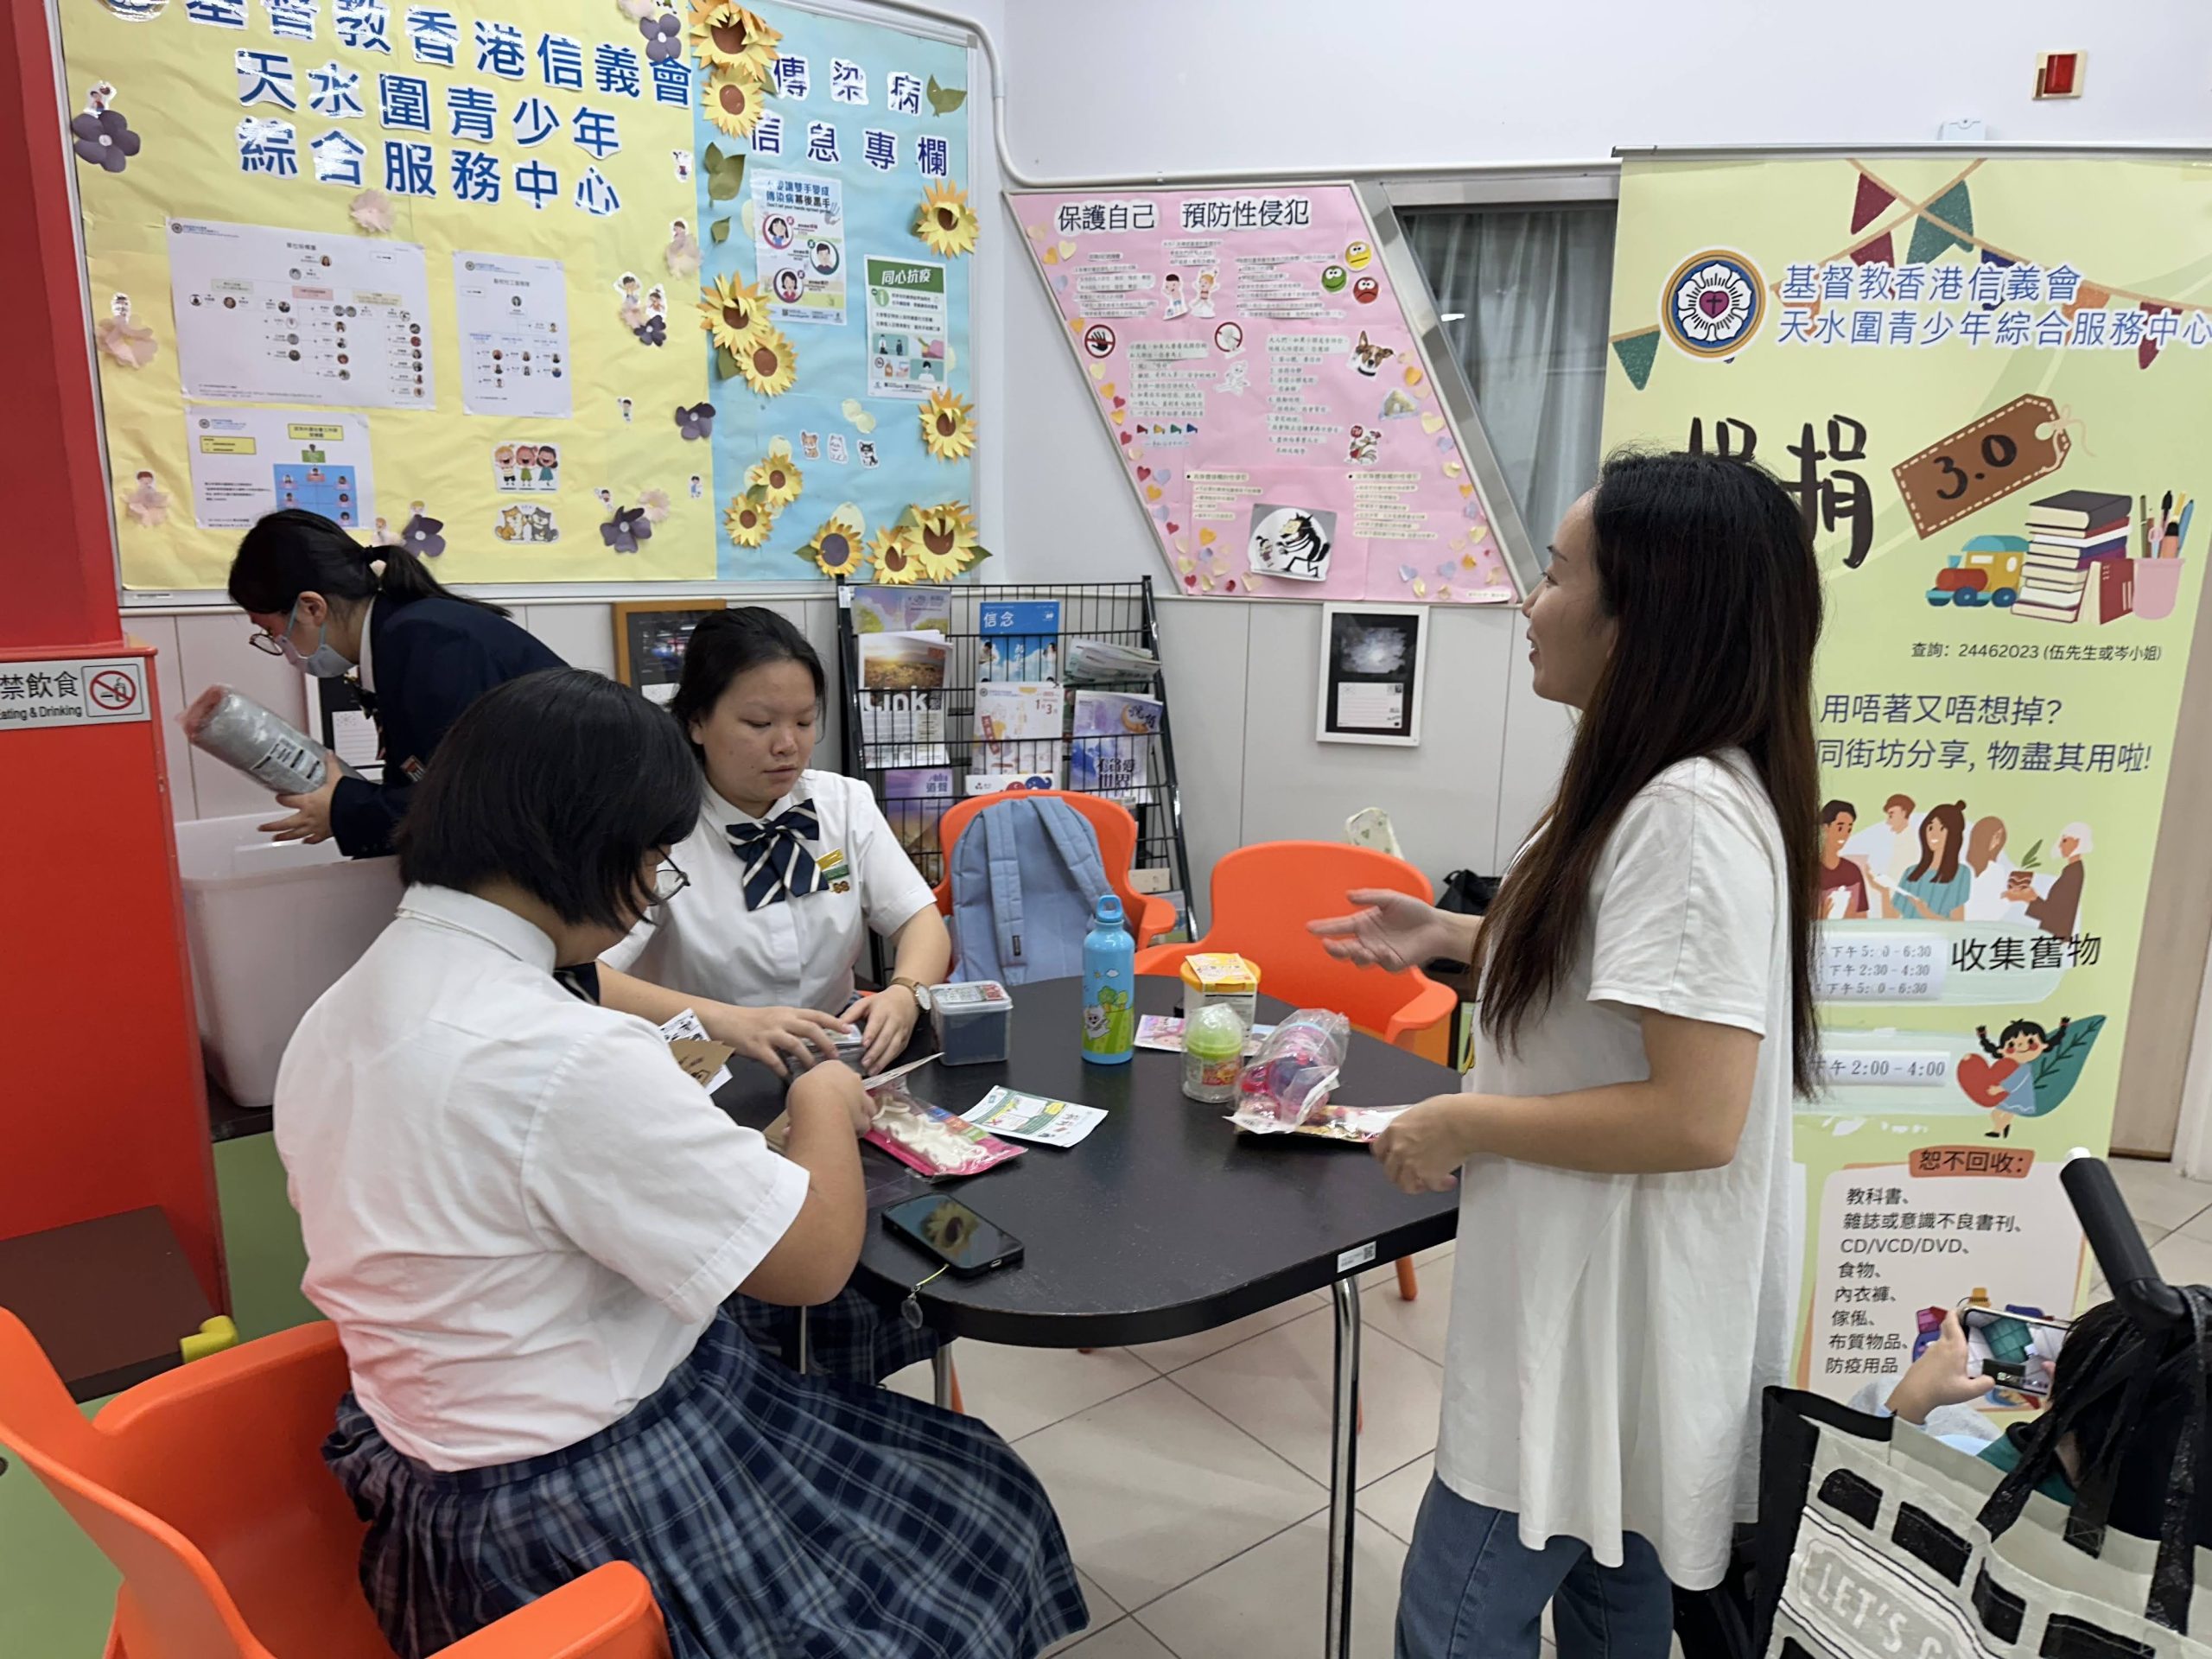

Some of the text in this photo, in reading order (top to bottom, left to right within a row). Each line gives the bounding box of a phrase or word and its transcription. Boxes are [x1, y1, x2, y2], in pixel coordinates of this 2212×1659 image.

[773, 57, 921, 114] 傳染病
[237, 50, 620, 156] 天水圍青少年
[752, 118, 947, 176] 信息專欄
[238, 118, 620, 214] 綜合服務中心
[1058, 199, 1309, 232] 保護自己 預防性侵犯
[881, 268, 931, 285] 同心抗疫
[1781, 264, 2082, 303] 基督教香港信義會
[1777, 309, 2212, 346] 天水圍青少年綜合服務中心
[1933, 434, 2018, 501] 3.0
[983, 611, 1014, 628] 信念
[1958, 644, 2039, 658] 24462023
[2044, 644, 2163, 661] (伍先生或岑小姐)
[0, 671, 79, 700] 禁飲食
[29, 707, 38, 718] &
[39, 706, 82, 718] Drinking
[1821, 693, 2063, 727] 用唔著又唔想掉?
[1816, 738, 2152, 773] 同街坊分享, 物盡其用啦!
[1951, 932, 2101, 972] 收集舊物
[1851, 1059, 1890, 1076] 2:00
[1907, 1060, 1946, 1077] 4:00
[1846, 1187, 1909, 1205] 教科書、
[1842, 1212, 2022, 1233] 雜誌或意識不良書刊、
[1840, 1237, 1969, 1255] CD/VCD/DVD、
[1838, 1261, 1881, 1279] 食物、
[1827, 1333, 1908, 1351] 布質物品、
[1825, 1357, 1898, 1375] 防疫用品
[1817, 1562, 1907, 1652] LET'S
